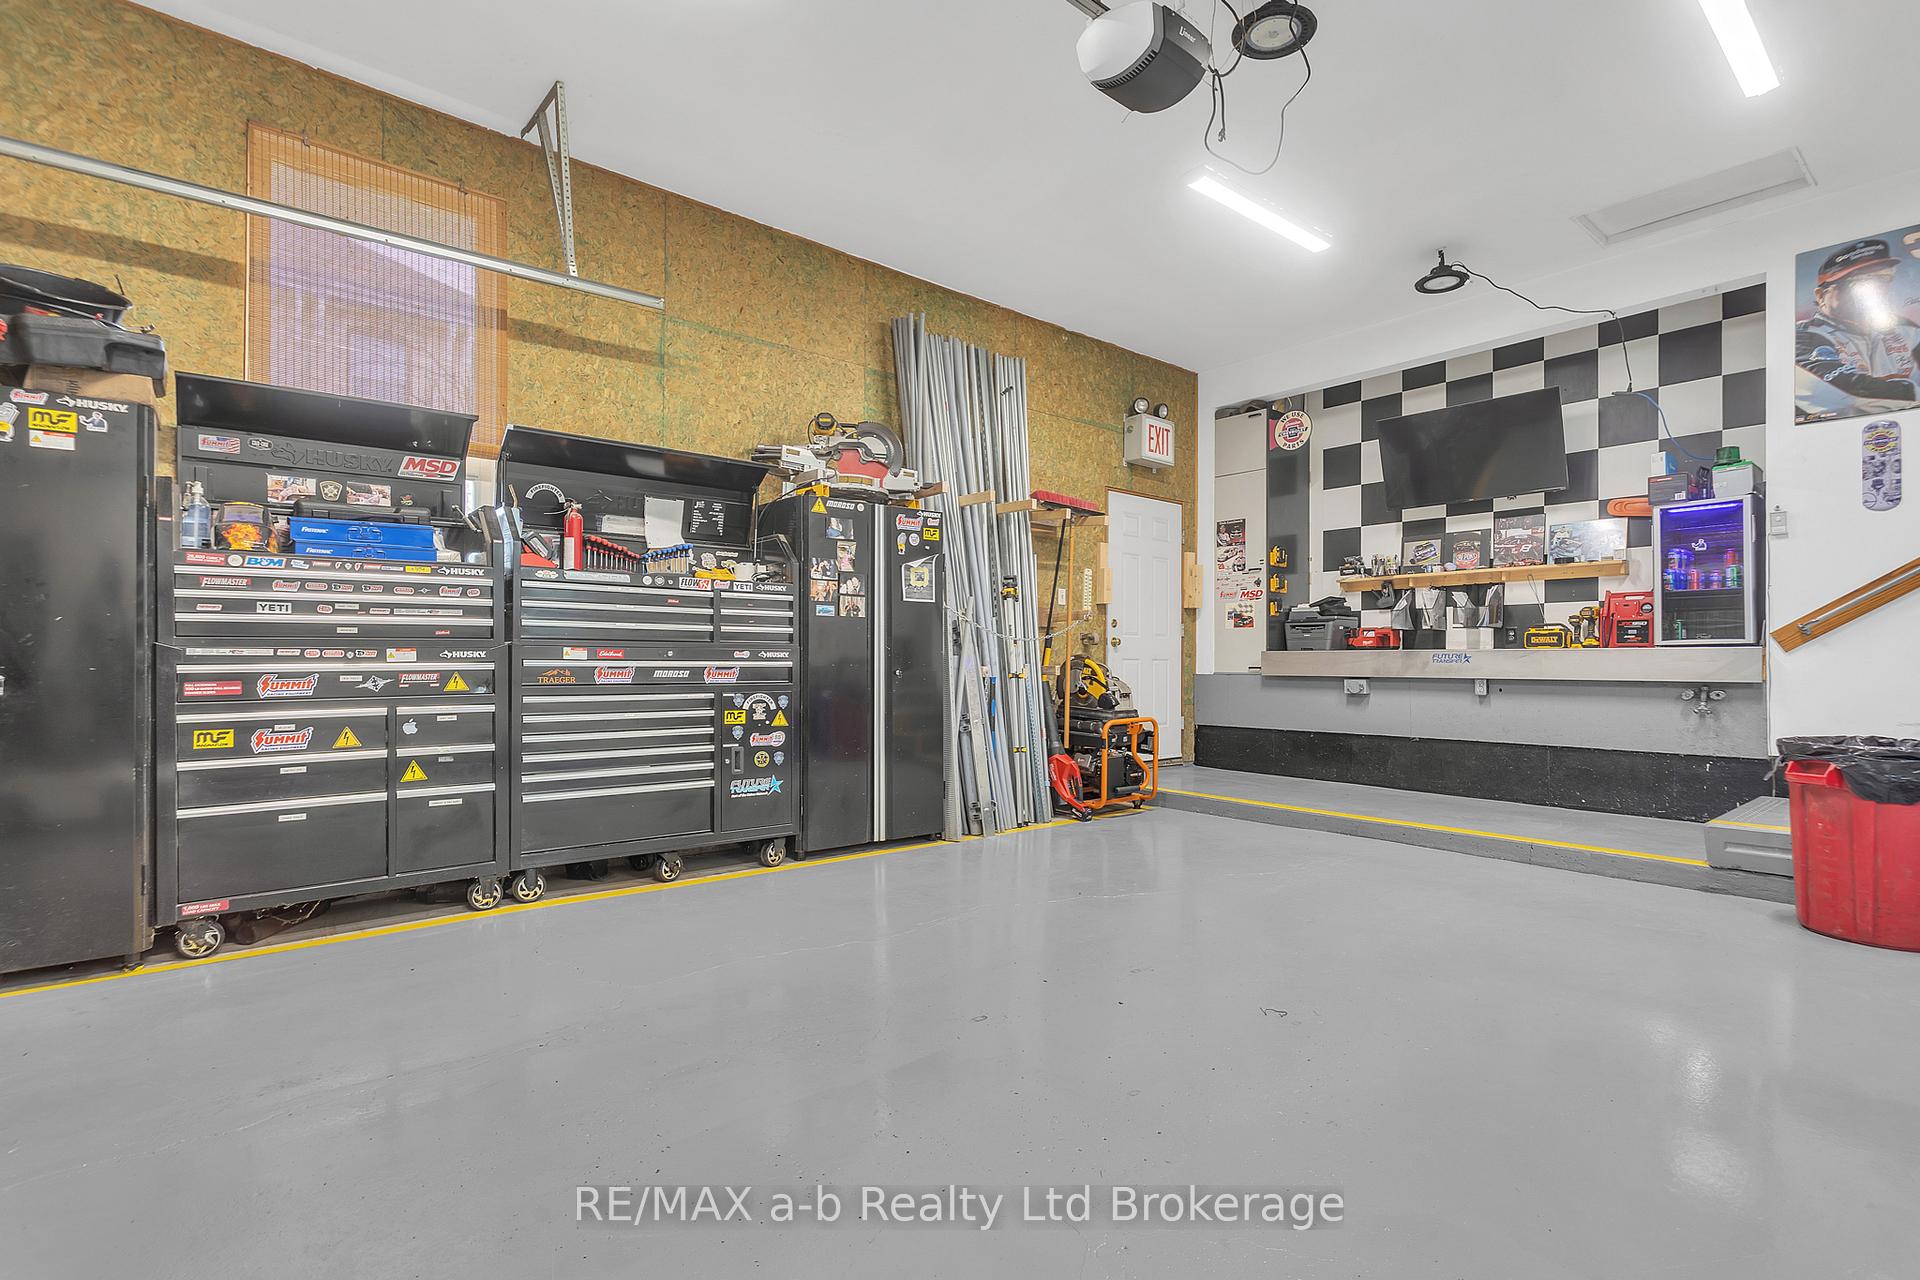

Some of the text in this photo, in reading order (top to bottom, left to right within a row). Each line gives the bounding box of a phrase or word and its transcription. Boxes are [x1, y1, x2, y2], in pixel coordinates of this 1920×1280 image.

[75, 398, 129, 413] HUSKY
[1148, 423, 1171, 457] EXIT
[403, 457, 457, 474] MSD
[245, 556, 284, 567] B&M
[449, 567, 485, 576] HUSKY
[201, 576, 248, 587] FLOWMASTER
[764, 584, 787, 592] HUSKY
[1240, 589, 1264, 599] MSD
[258, 603, 290, 612] YETI
[452, 650, 487, 658] HUSKY
[400, 673, 438, 683] FLOWMASTER
[537, 676, 576, 684] TRAEGER
[196, 731, 232, 744] MF
